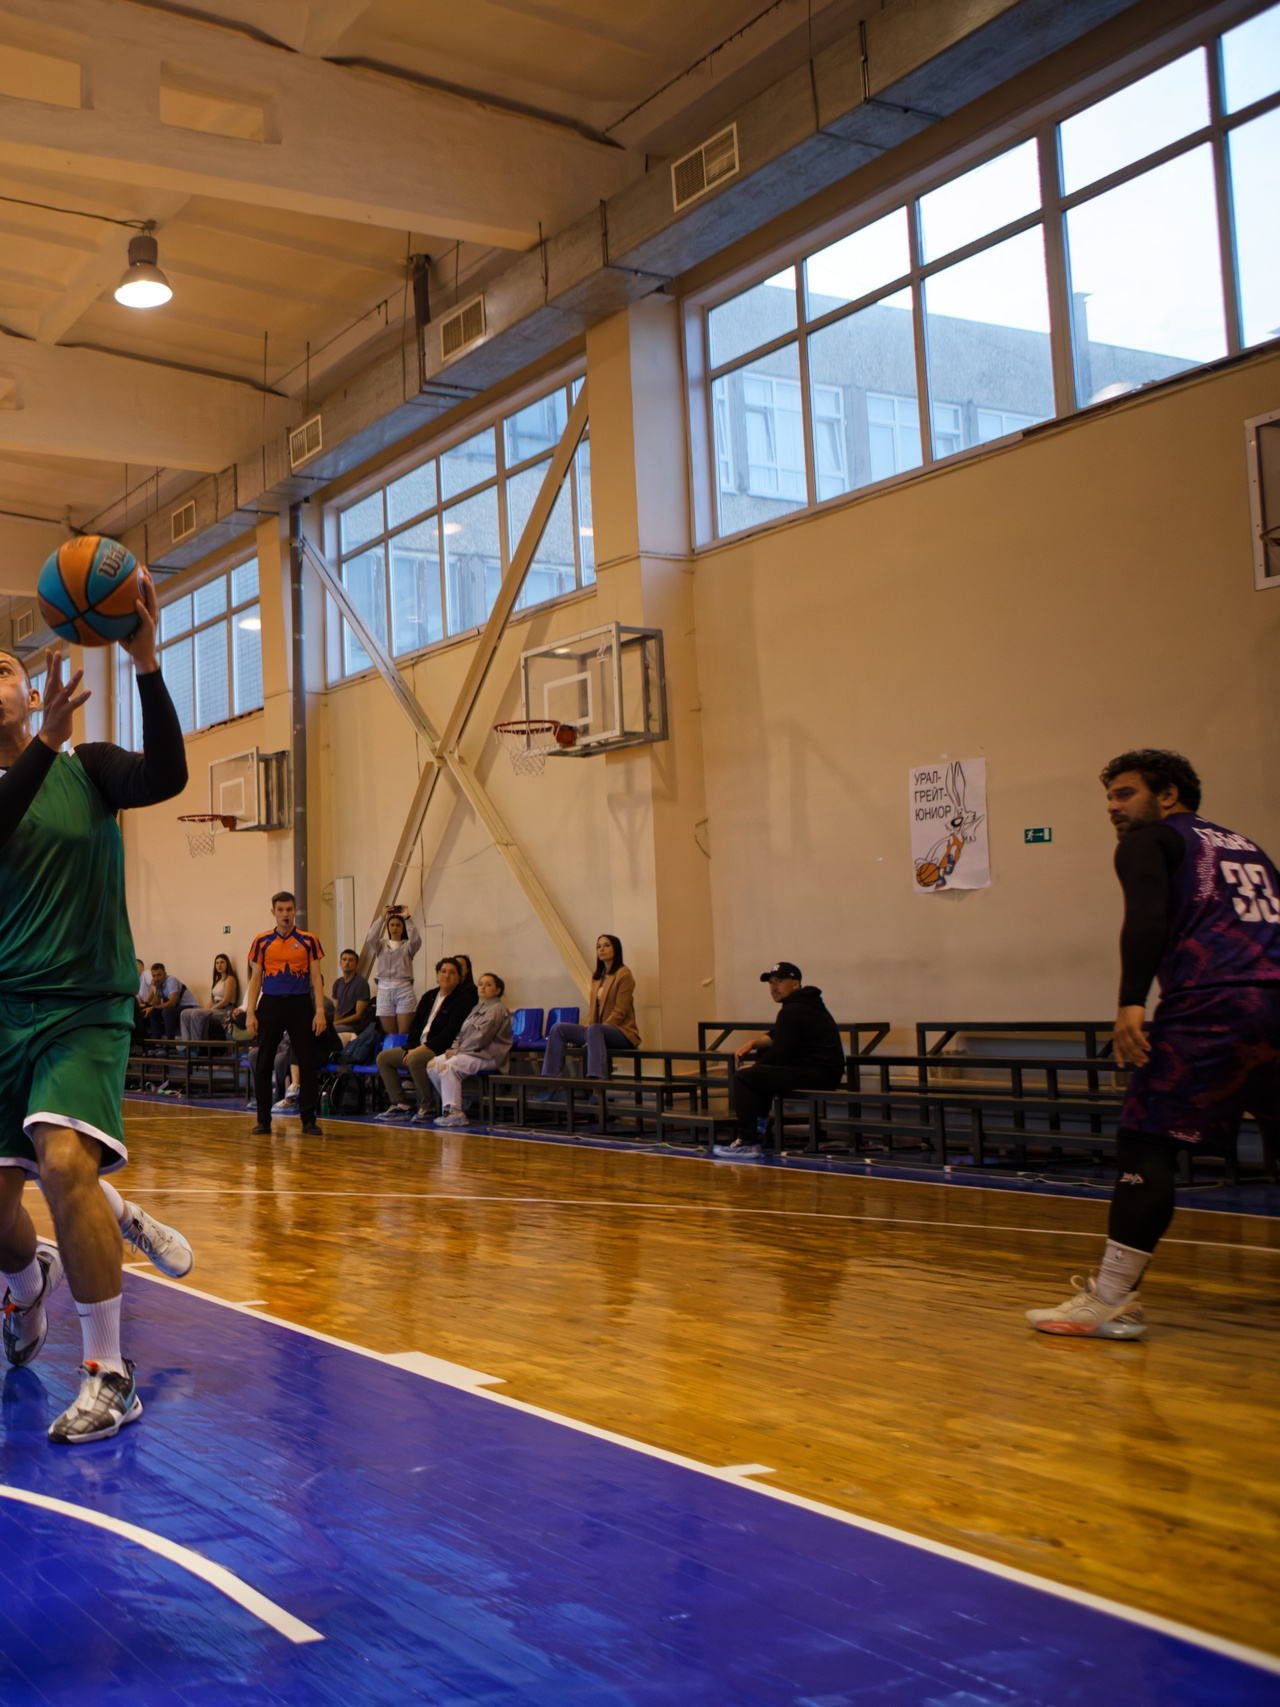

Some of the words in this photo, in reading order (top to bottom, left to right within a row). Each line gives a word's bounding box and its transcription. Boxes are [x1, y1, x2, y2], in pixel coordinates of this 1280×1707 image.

[914, 771, 941, 786] УРАЛ-
[914, 786, 947, 803] ГРЕЙТ-
[915, 805, 951, 821] ЮНИОР
[1220, 860, 1280, 924] 33
